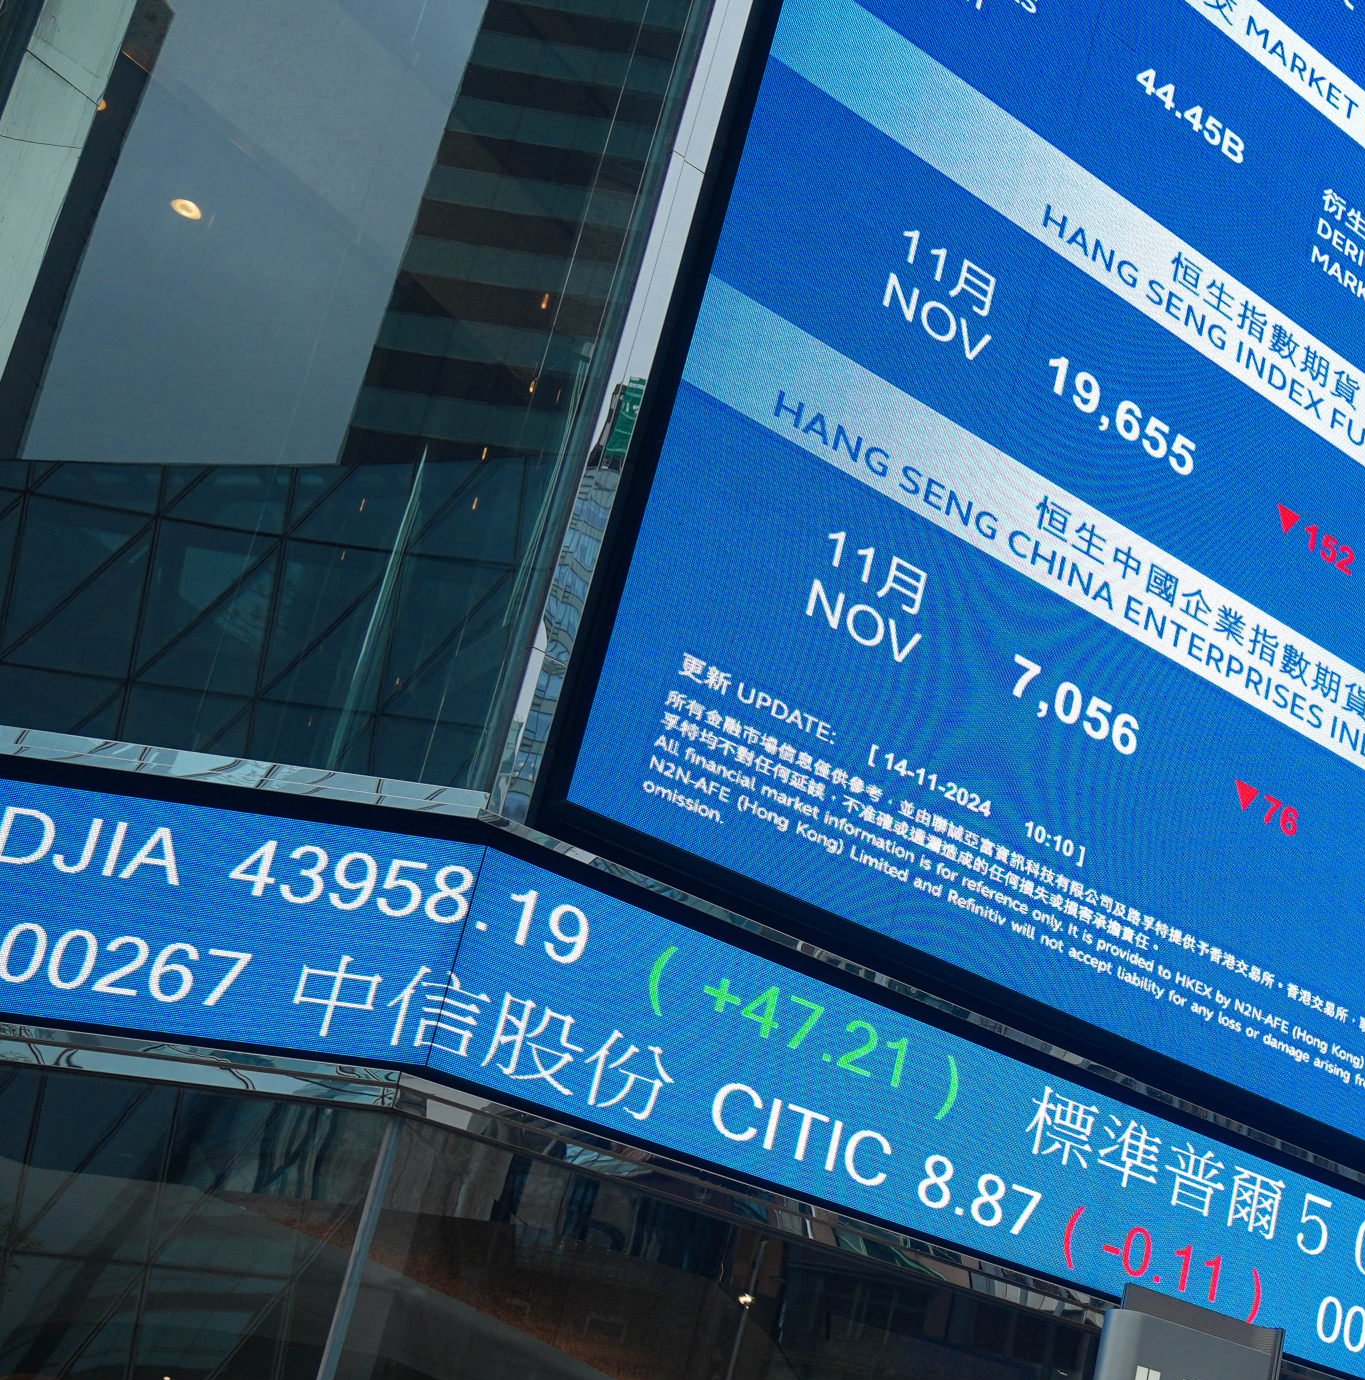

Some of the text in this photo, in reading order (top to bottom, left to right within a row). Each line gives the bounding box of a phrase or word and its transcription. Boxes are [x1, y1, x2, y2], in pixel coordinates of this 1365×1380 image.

[1135, 68, 1245, 164] 44.45B
[1246, 14, 1359, 120] MARKET
[882, 273, 992, 361] NOV
[902, 229, 997, 318] 11月
[1041, 204, 1138, 289] HANG
[1146, 280, 1227, 351] SENG
[1237, 341, 1323, 422] INDEX
[1170, 250, 1361, 411] 恒生指數期貨
[1047, 356, 1197, 477] 19,655
[774, 391, 889, 478] HANG
[899, 466, 998, 541] SENG
[1008, 529, 1114, 612] CHINA
[1124, 600, 1323, 731] ENTERPRISES
[827, 531, 928, 617] 11月
[805, 580, 922, 664] NOV
[678, 652, 1075, 857] 更新 UPDATE: 14-11-2024 10:10
[1010, 655, 1139, 755] 7,056
[642, 780, 725, 825] omission.
[1263, 795, 1299, 837] 76
[0, 806, 181, 887] DJIA
[228, 839, 591, 966] 43958.19
[703, 977, 909, 1089] +47.21
[650, 754, 732, 803] N2N-AFE
[737, 794, 790, 832] (Hong
[796, 819, 845, 856] Kong)
[850, 844, 909, 883] Limited
[914, 875, 943, 898] and
[947, 888, 1007, 927] Refinitiv
[1040, 932, 1065, 953] not
[1068, 946, 1112, 976] accept
[1116, 964, 1165, 1001] liability
[1190, 1000, 1214, 1022] any
[1263, 1033, 1311, 1063] damage
[1313, 1055, 1351, 1085] arising
[654, 734, 681, 757] All
[685, 747, 757, 792] financial
[761, 784, 820, 821] market
[823, 811, 915, 863] information
[961, 875, 1029, 915] reference
[1096, 937, 1155, 973] provided
[1175, 971, 1213, 999] HKEX
[1234, 998, 1289, 1034] N2N-AFE
[1292, 1024, 1329, 1055] (Hong
[1331, 1042, 1365, 1070] Kong)
[0, 922, 254, 1008] 00267
[291, 954, 674, 1122] 中信股份
[711, 1082, 893, 1188] CITIC
[916, 1154, 1044, 1237] 8.87
[1102, 1226, 1224, 1303] -0.11
